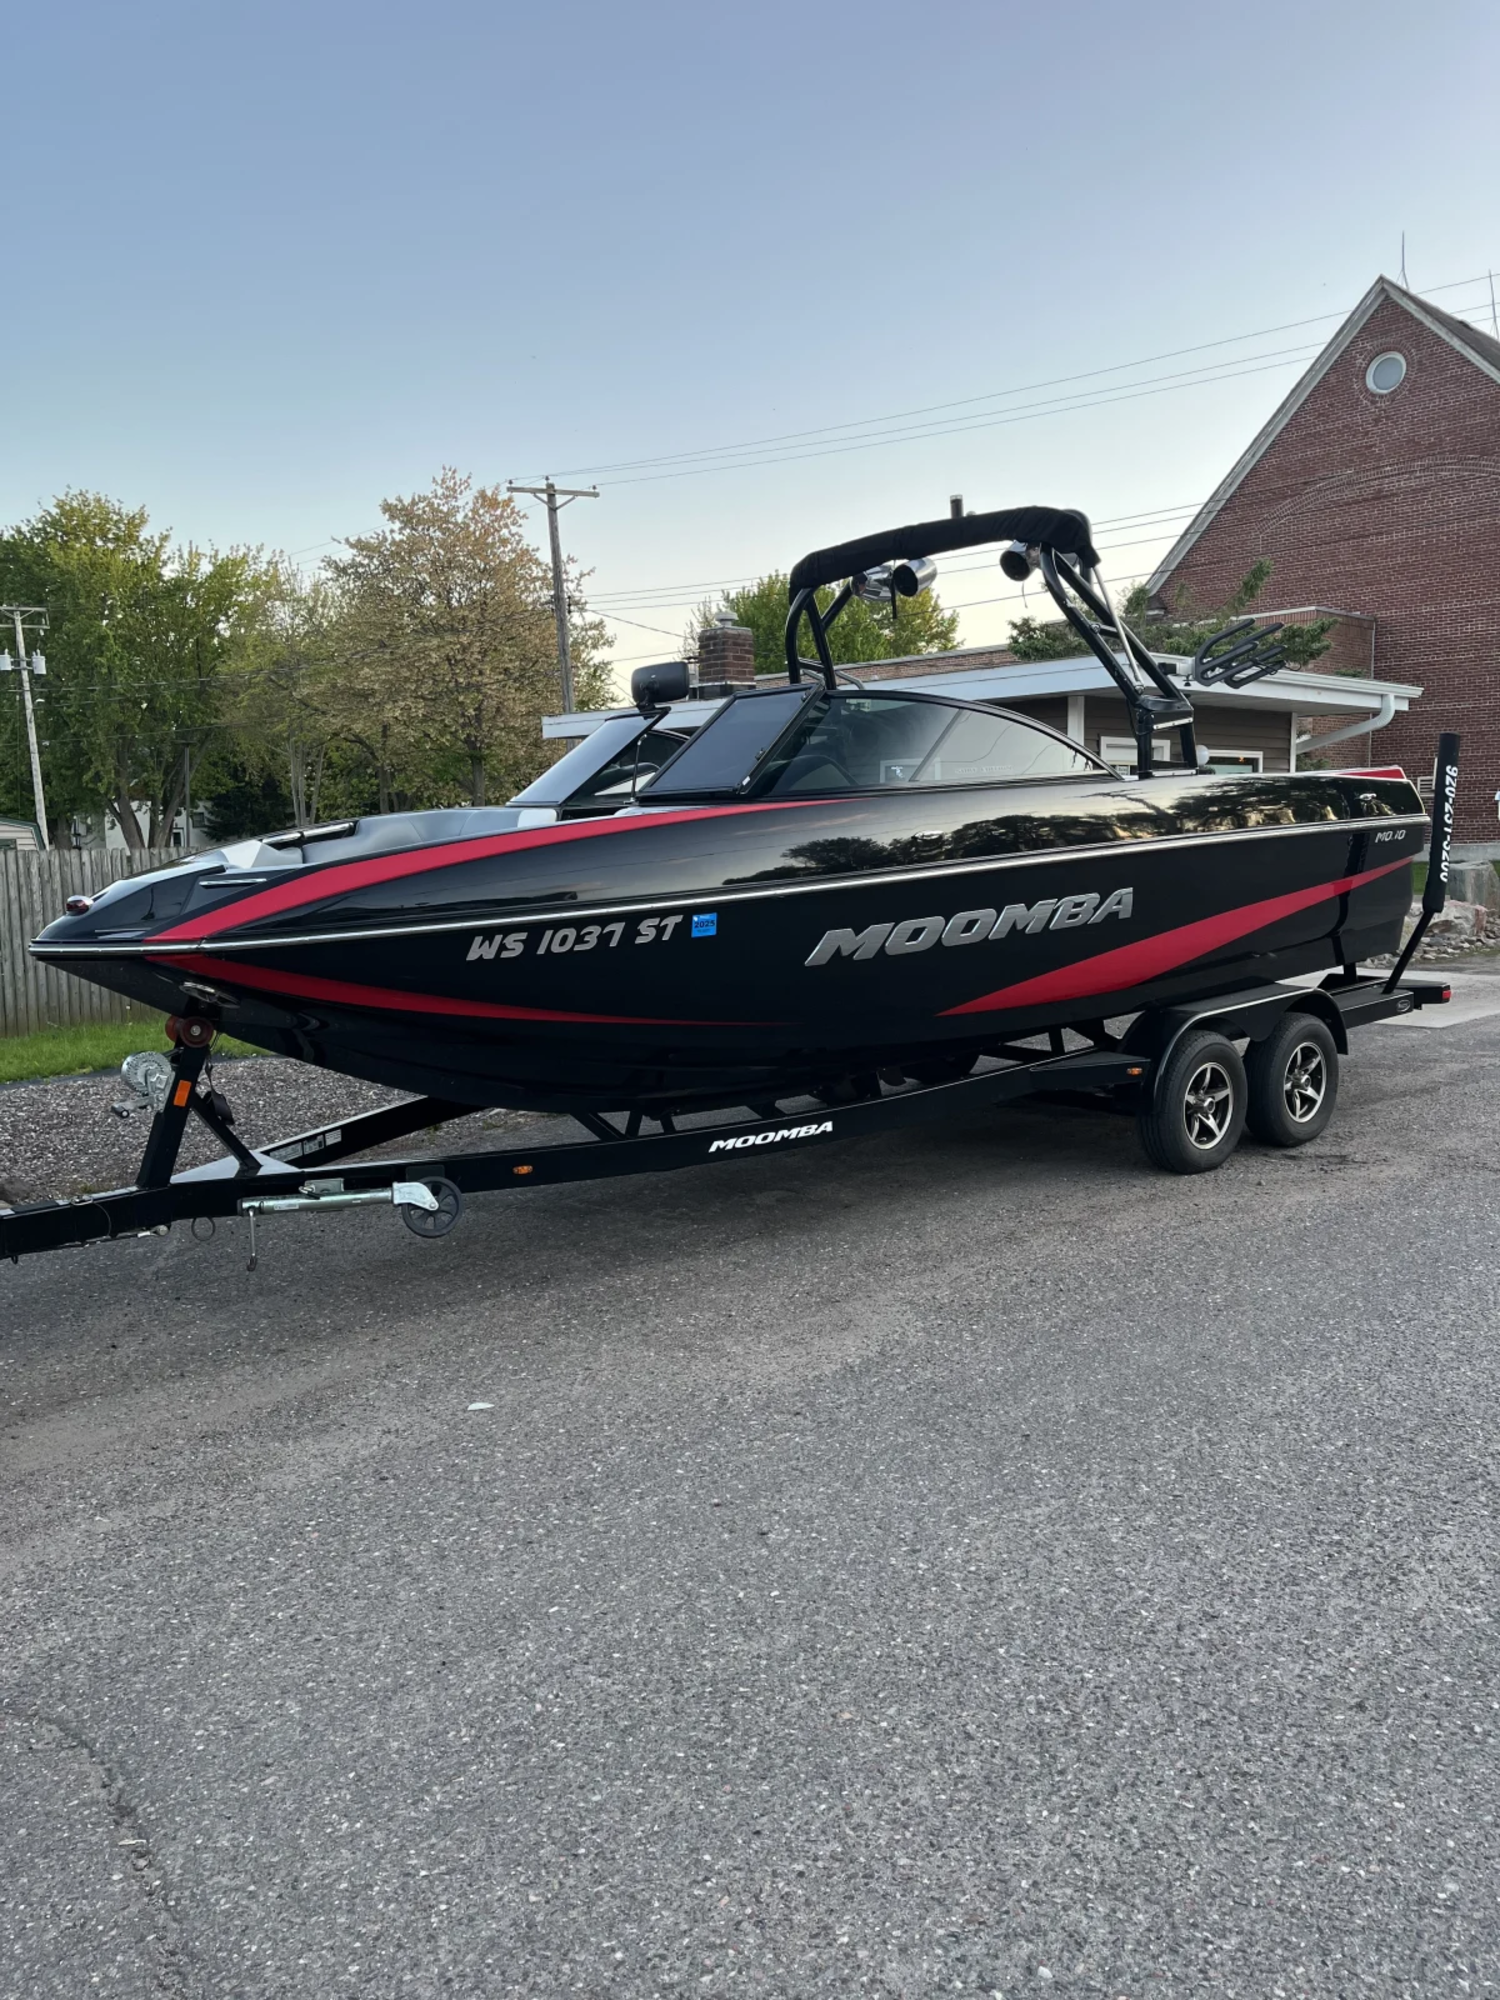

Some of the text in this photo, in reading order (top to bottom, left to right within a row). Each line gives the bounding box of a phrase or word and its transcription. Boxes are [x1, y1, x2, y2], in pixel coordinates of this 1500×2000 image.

[466, 915, 684, 961] WS 1037 ST
[694, 919, 716, 929] 2025
[804, 887, 1134, 967] MOOMBA
[708, 1121, 833, 1153] MOOMBA
